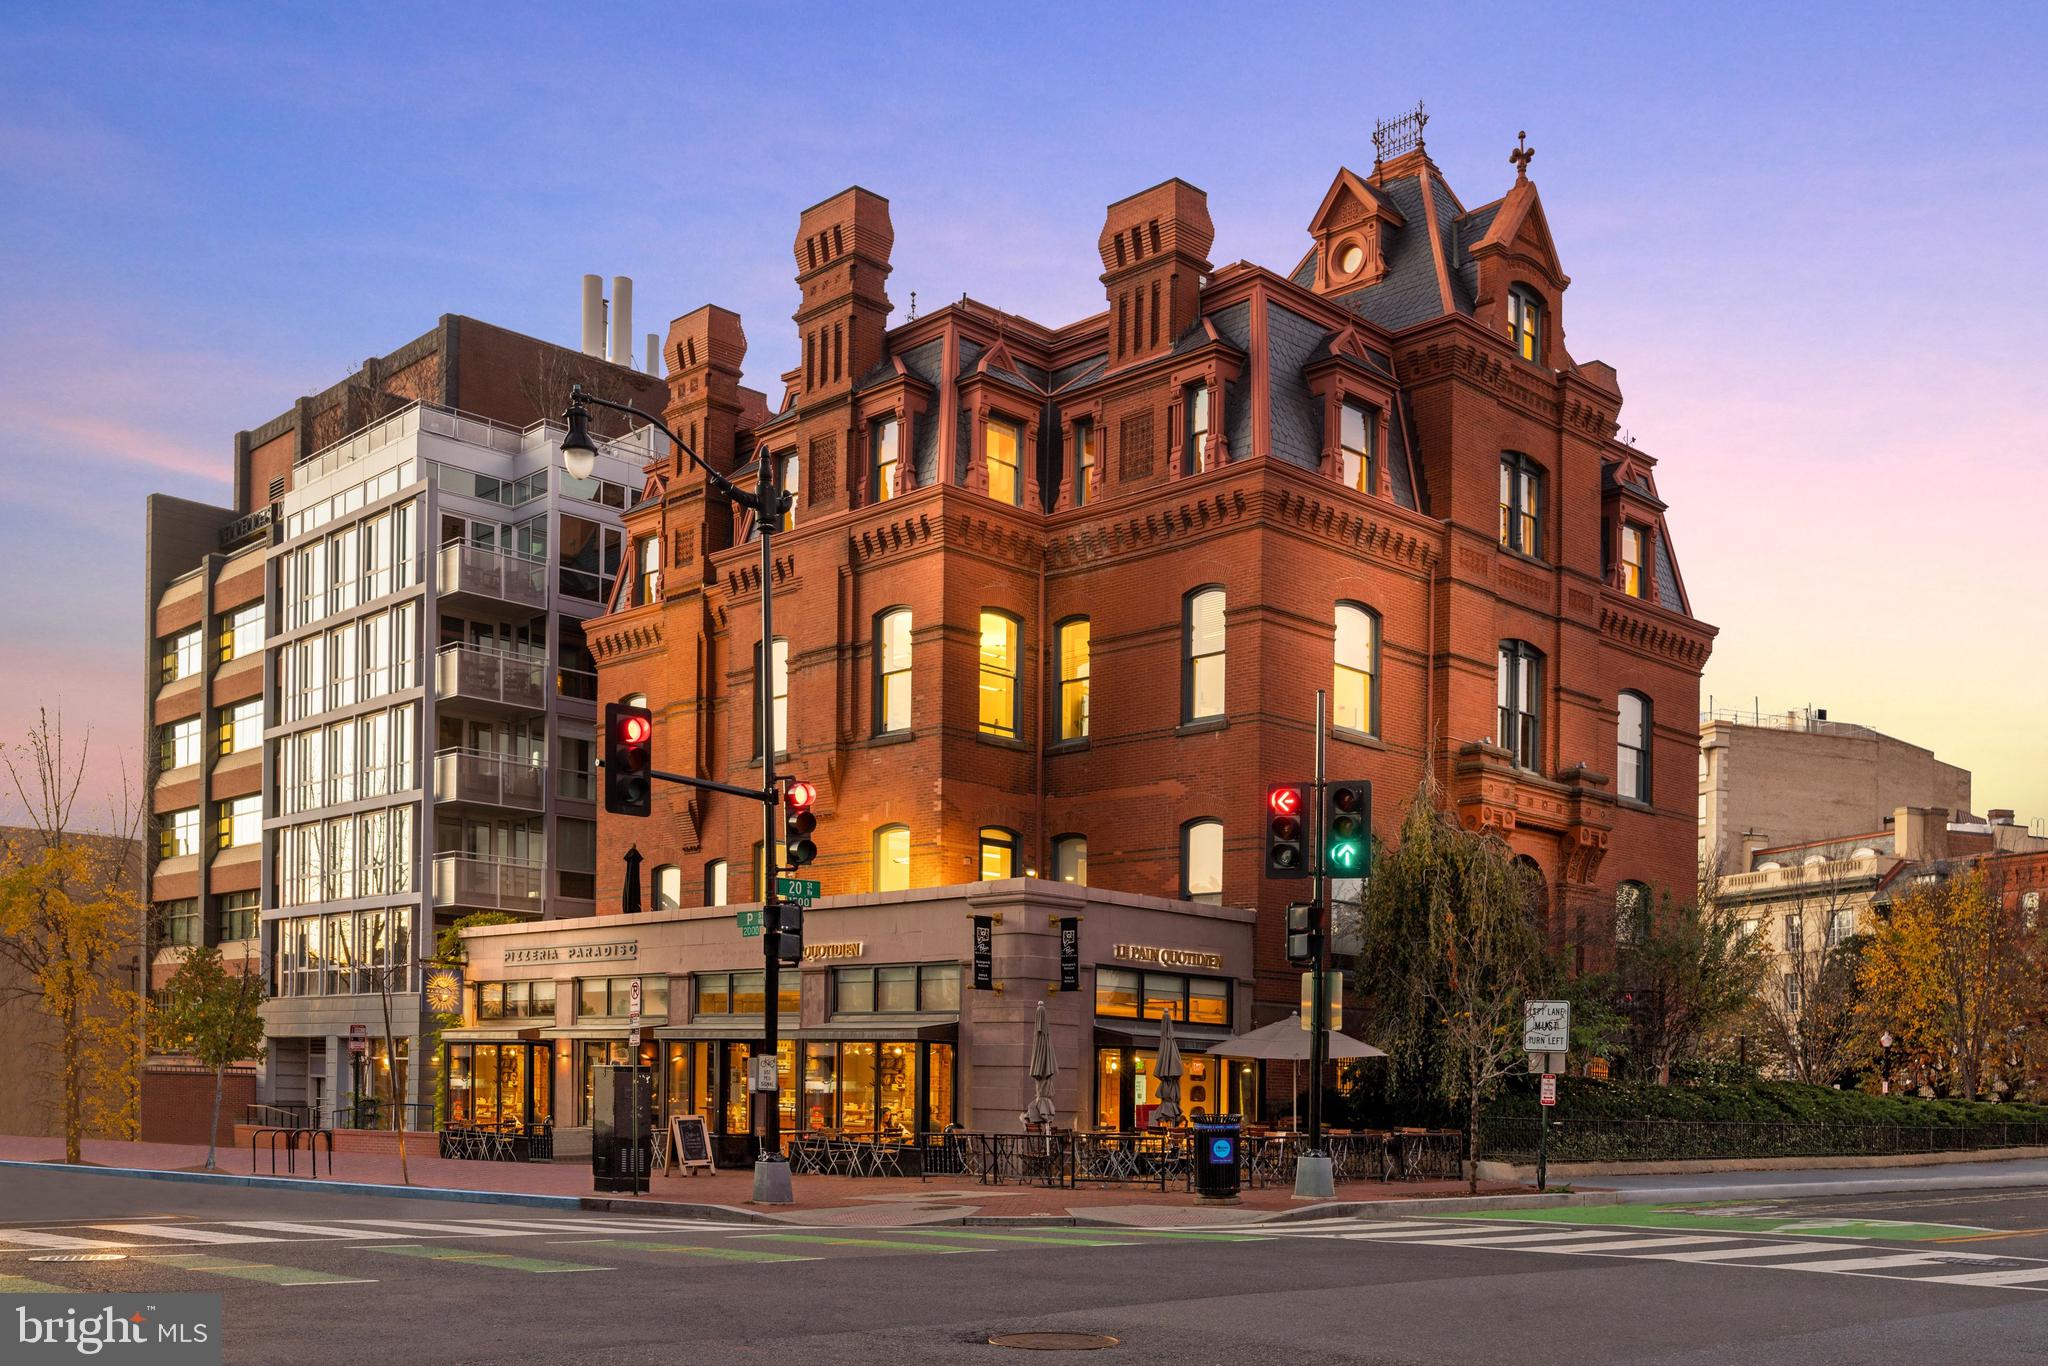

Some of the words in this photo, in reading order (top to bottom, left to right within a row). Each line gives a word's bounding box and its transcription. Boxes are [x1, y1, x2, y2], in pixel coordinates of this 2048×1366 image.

[789, 881, 802, 895] 20
[789, 897, 810, 907] 00
[747, 913, 753, 925] P
[743, 926, 759, 936] 2000
[504, 949, 559, 963] PIZZERIA
[569, 944, 638, 959] PARADISO
[804, 942, 863, 962] QUOTIDIEN
[1114, 944, 1130, 960] LE
[1130, 945, 1160, 963] PAIN
[1159, 948, 1224, 968] QUOTIDIEN
[1548, 1008, 1565, 1016] LANE
[1535, 1021, 1559, 1031] MUST
[1528, 1036, 1545, 1045] TURN
[1548, 1036, 1564, 1045] LEFT
